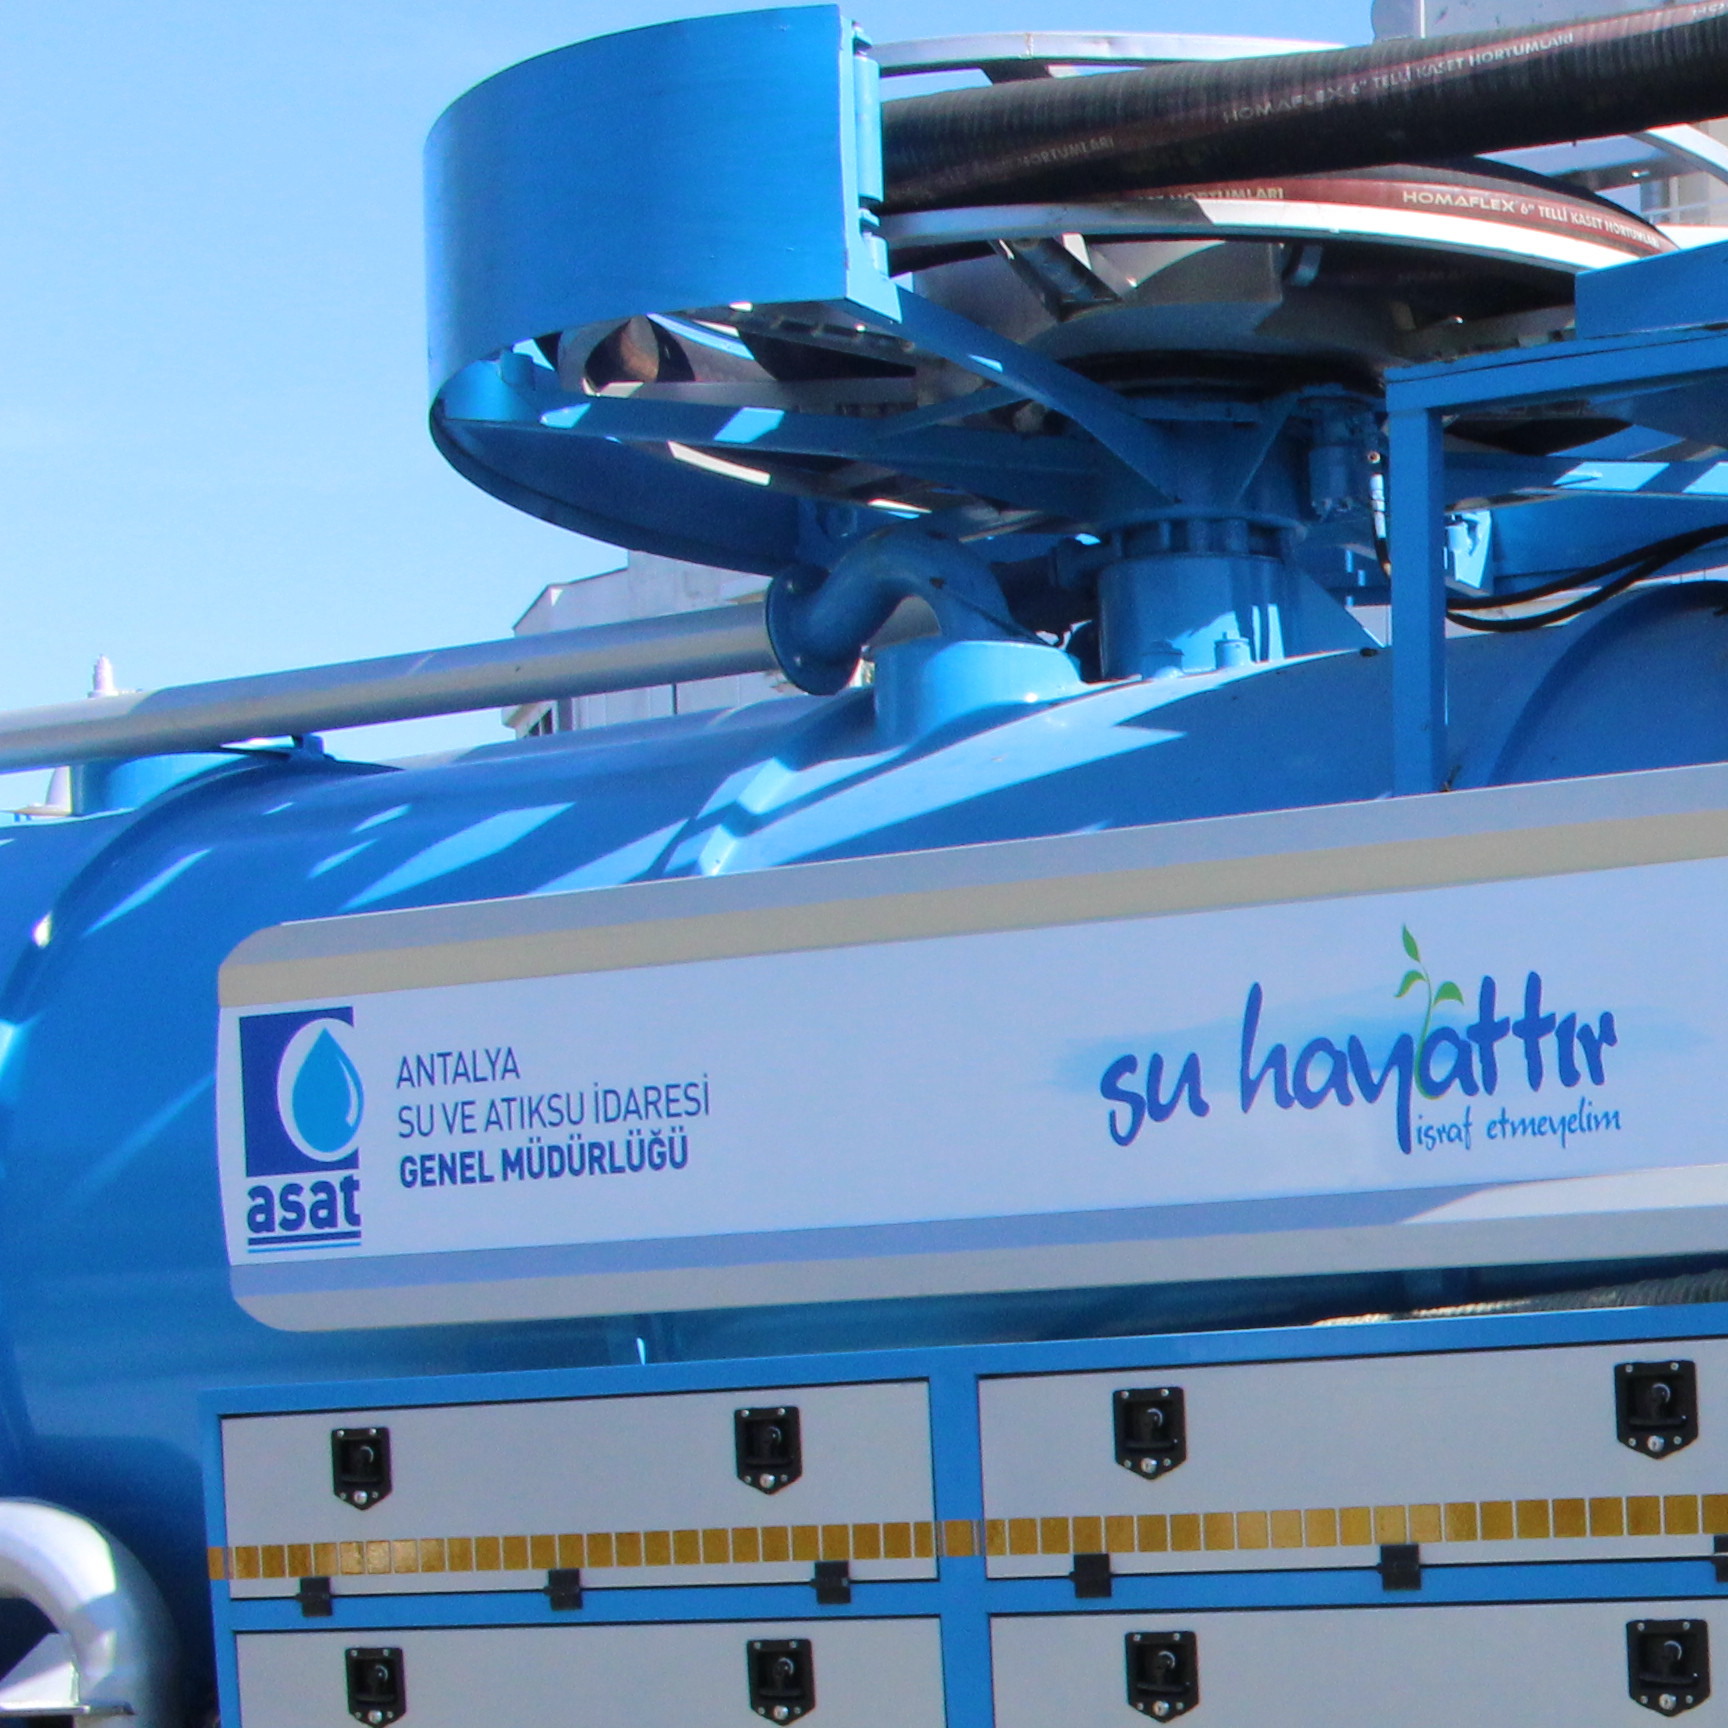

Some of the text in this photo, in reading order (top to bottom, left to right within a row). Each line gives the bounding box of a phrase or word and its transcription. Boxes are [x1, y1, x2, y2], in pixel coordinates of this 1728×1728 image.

[1223, 86, 1343, 124] HOMAFLEX
[1416, 57, 1465, 80] KASET
[1469, 32, 1574, 67] HORTUMLARI
[1403, 191, 1516, 213] HOMAFLEX
[1539, 205, 1568, 223] TELLİ
[1571, 211, 1602, 230] KASET
[396, 1046, 521, 1089] ANTALYA
[1100, 970, 1618, 1154] su hayattır
[399, 1072, 711, 1139] SU VE ATIKSU İDARESİ
[1416, 1096, 1622, 1153] israf etmeyelim
[400, 1125, 689, 1188] GENEL MÜDÜRLÜĞÜ
[246, 1173, 361, 1234] asat
